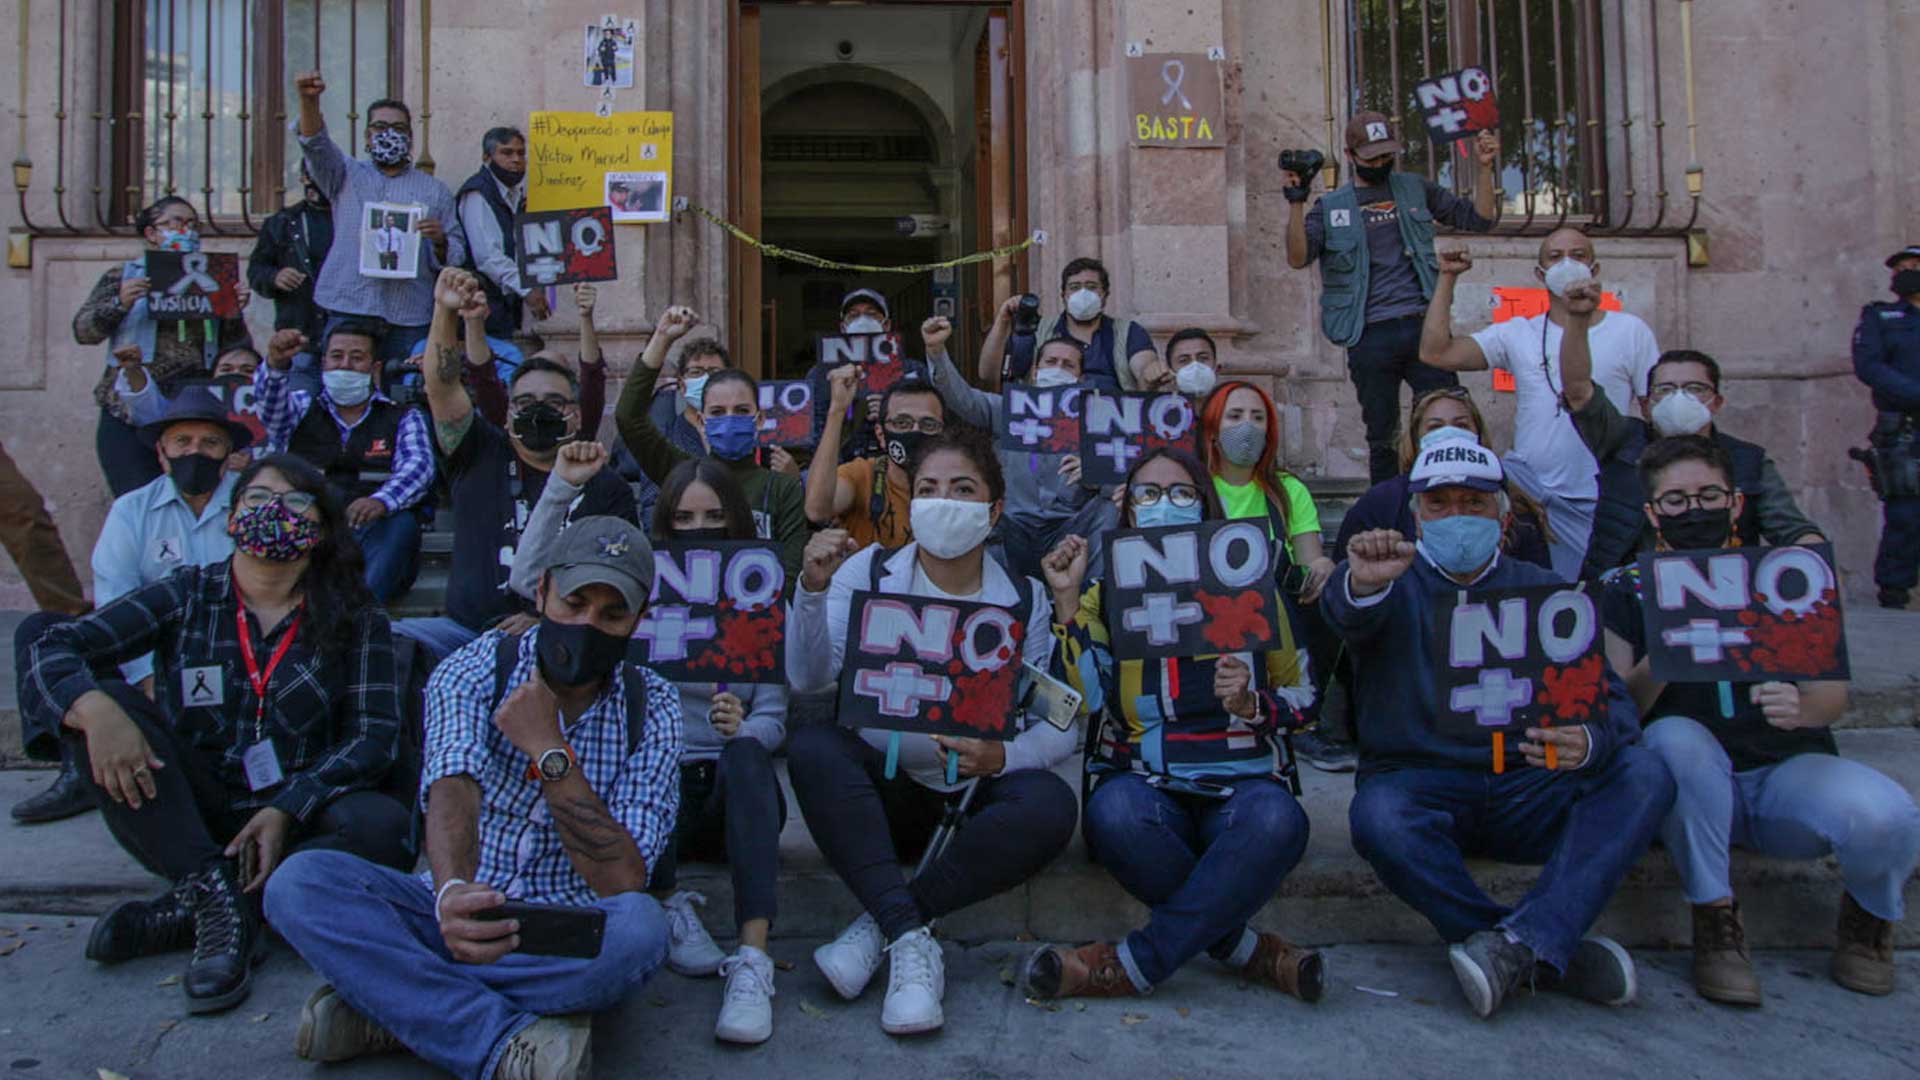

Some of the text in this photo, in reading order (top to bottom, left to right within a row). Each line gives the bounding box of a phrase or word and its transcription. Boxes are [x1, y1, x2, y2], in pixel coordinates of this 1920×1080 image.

[1417, 67, 1490, 109] NO
[1136, 113, 1213, 139] BASTA
[522, 216, 605, 256] NO
[822, 333, 898, 364] NO
[208, 384, 256, 416] O
[1085, 394, 1194, 440] NO
[1424, 445, 1489, 466] PRENSA
[1112, 522, 1269, 589] NO
[650, 547, 785, 612] NO
[1653, 546, 1835, 618] NO
[859, 599, 1019, 673] NO
[1450, 589, 1596, 664] NO
